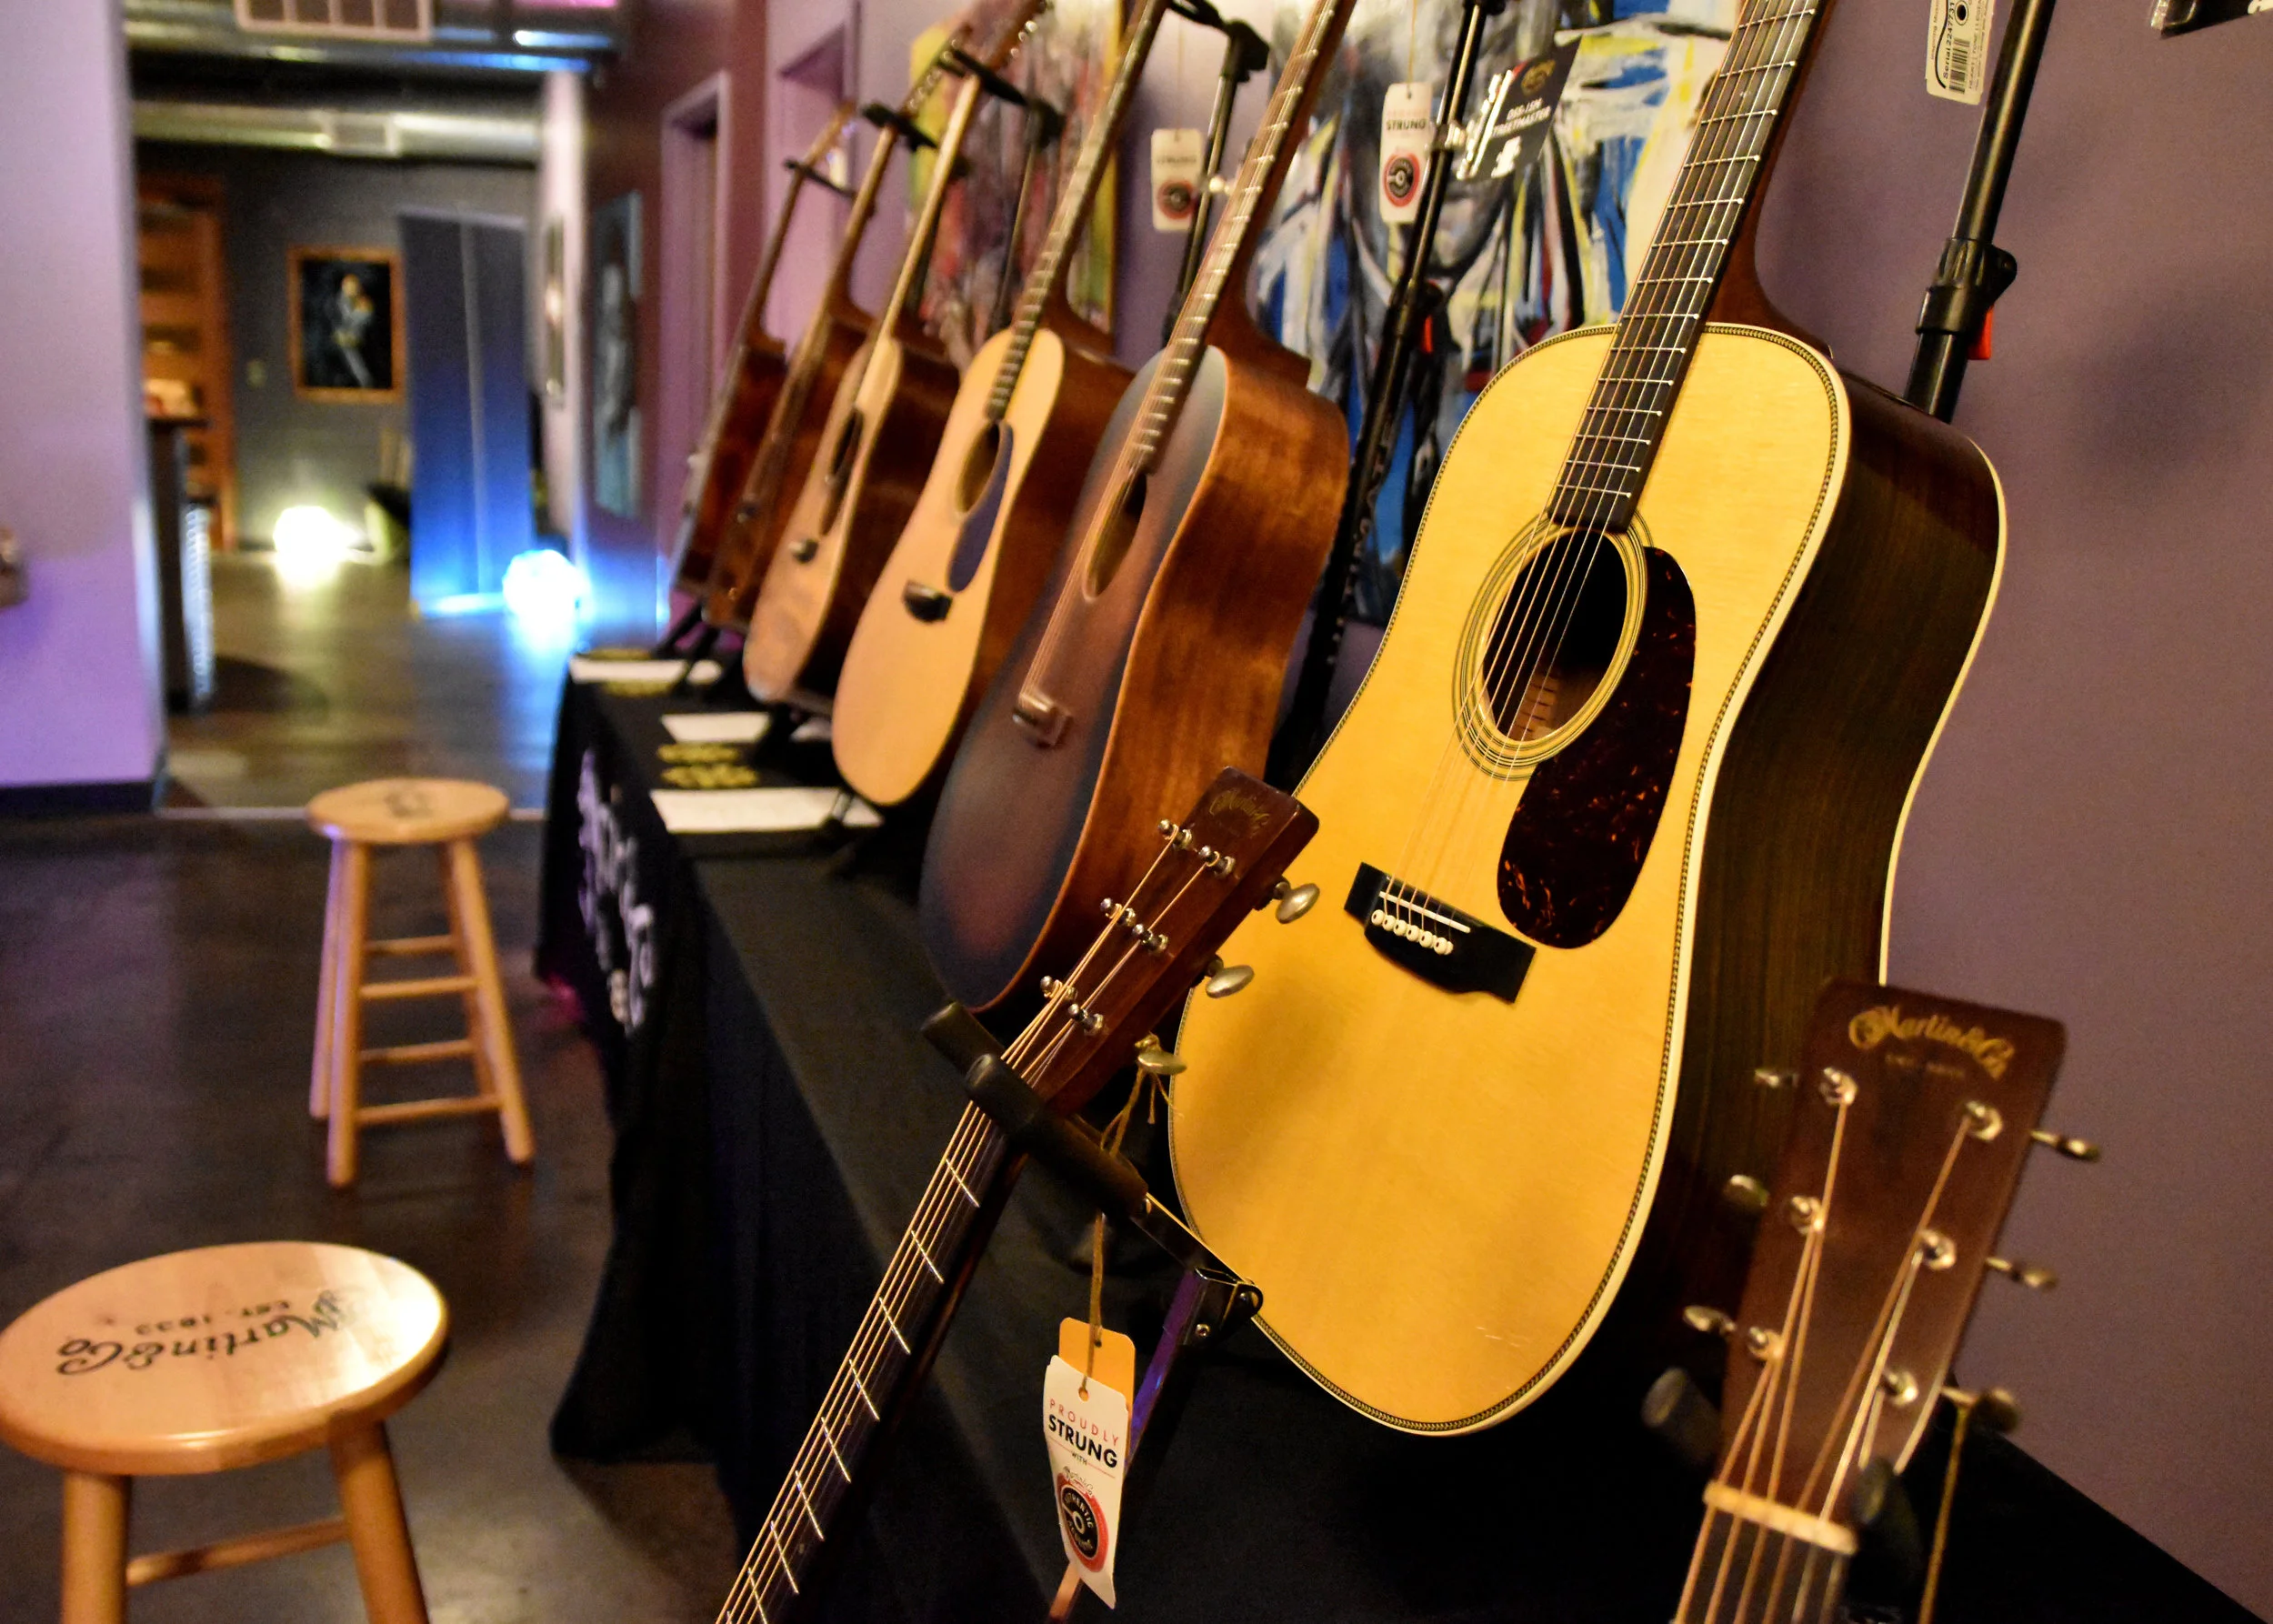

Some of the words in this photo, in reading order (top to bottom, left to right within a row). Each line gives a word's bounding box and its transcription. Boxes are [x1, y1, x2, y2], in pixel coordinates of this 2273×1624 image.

[1943, 48, 1951, 79] Serial
[1947, 3, 1956, 45] 2247731
[1387, 118, 1427, 131] STRUNG
[1048, 1413, 1118, 1469] STRUNG
[1049, 1398, 1119, 1447] PROUDLY
[1071, 1451, 1088, 1466] WITH
